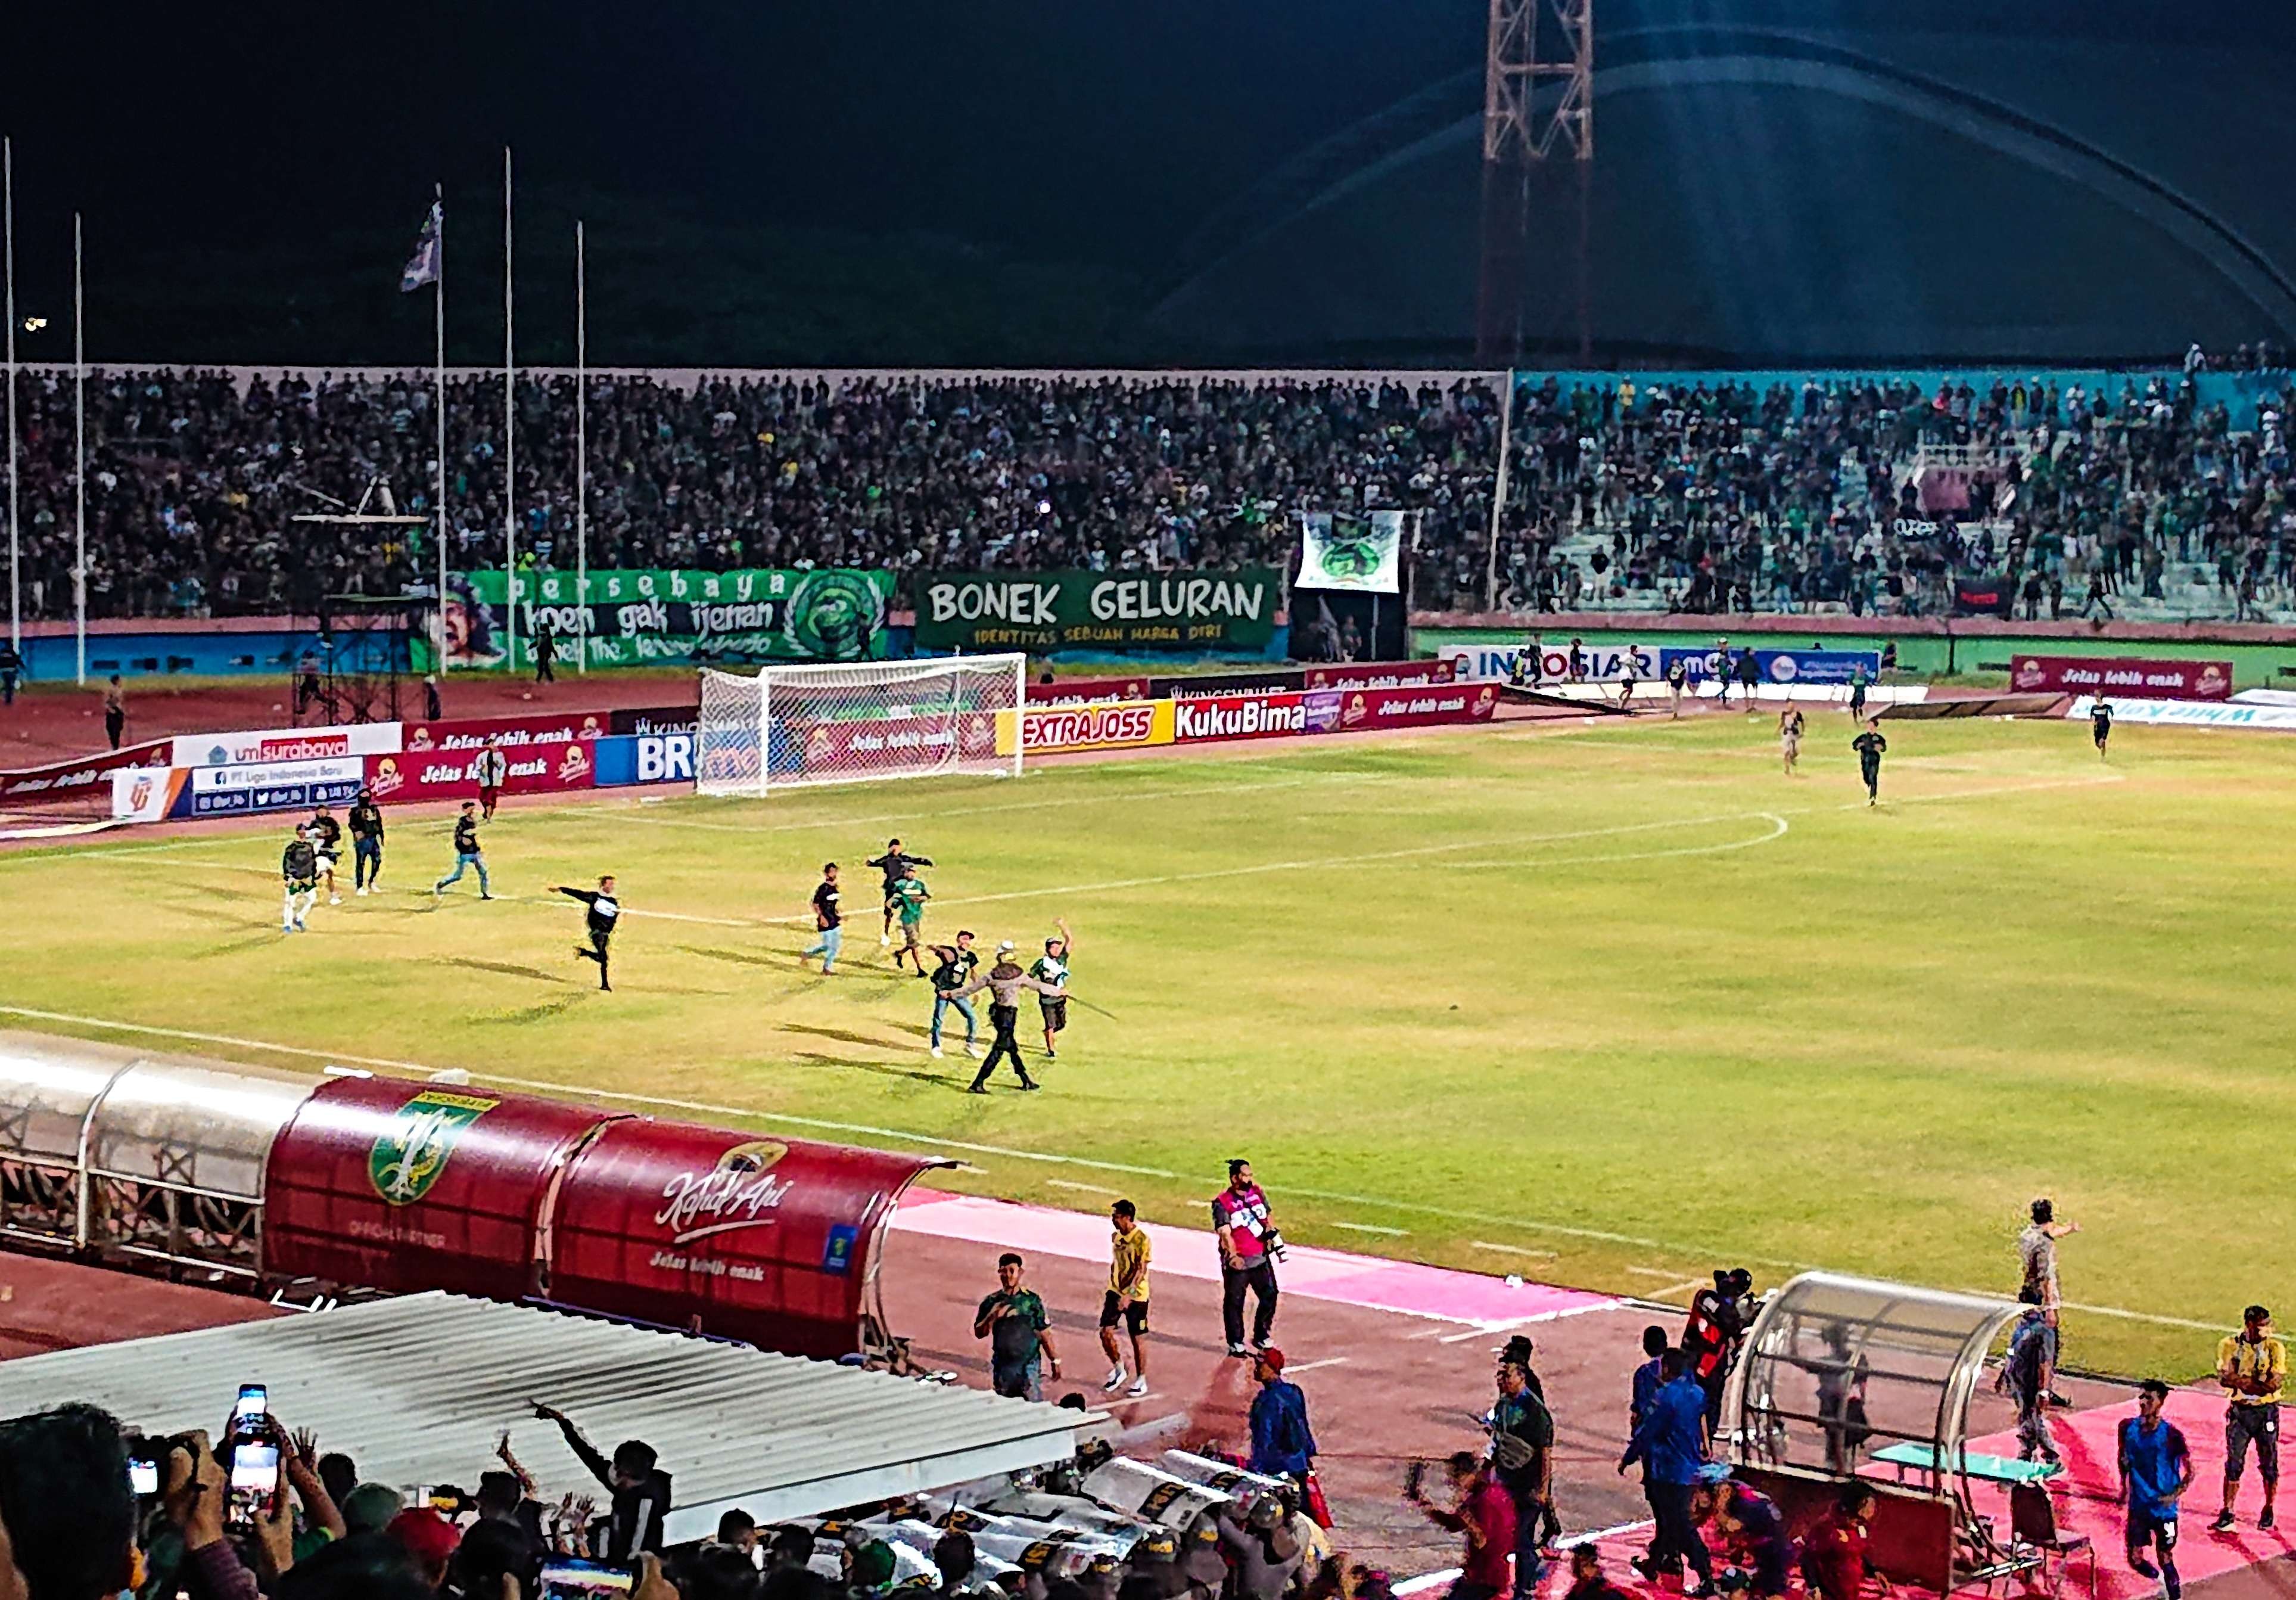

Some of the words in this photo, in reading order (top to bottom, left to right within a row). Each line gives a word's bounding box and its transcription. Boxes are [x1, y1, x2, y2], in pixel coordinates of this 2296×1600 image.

[928, 582, 1060, 625] BONEK
[1091, 578, 1264, 622] GELURAN
[618, 595, 667, 637] gak
[975, 629, 1057, 645] IDENTITAS
[1064, 626, 1123, 642] SEBUAH
[1132, 626, 1180, 641] HARGA
[1188, 625, 1221, 638] DIRI
[1479, 652, 1651, 677] INOSIAR
[1176, 700, 1306, 738] KukuBima
[420, 765, 462, 784] Jelas
[508, 758, 547, 777] enak
[649, 1251, 687, 1269] Jelas
